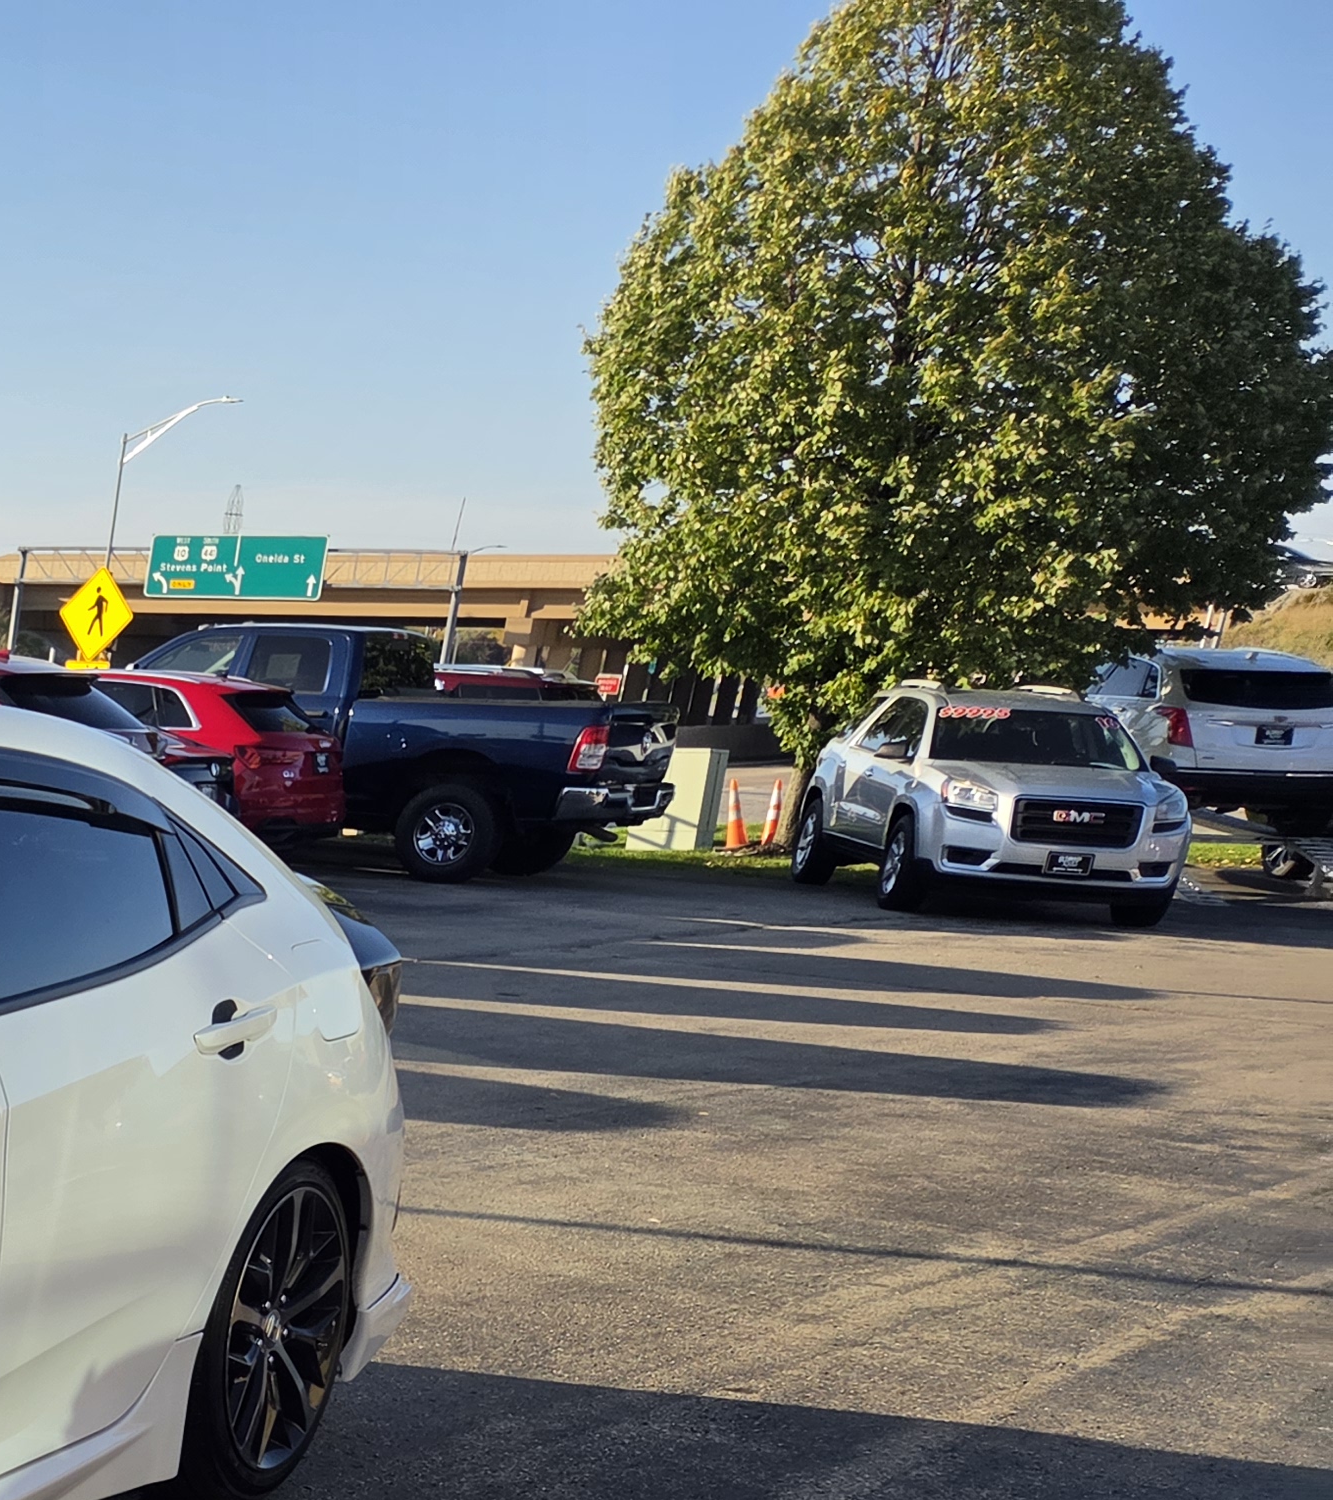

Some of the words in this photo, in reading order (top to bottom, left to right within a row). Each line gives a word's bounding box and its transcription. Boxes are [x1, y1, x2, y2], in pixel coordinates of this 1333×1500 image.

[177, 549, 187, 557] 10
[255, 553, 289, 563] Oneida
[293, 553, 305, 564] St
[160, 562, 197, 572] Stevens
[200, 562, 228, 572] Point
[1053, 810, 1105, 824] GMC
